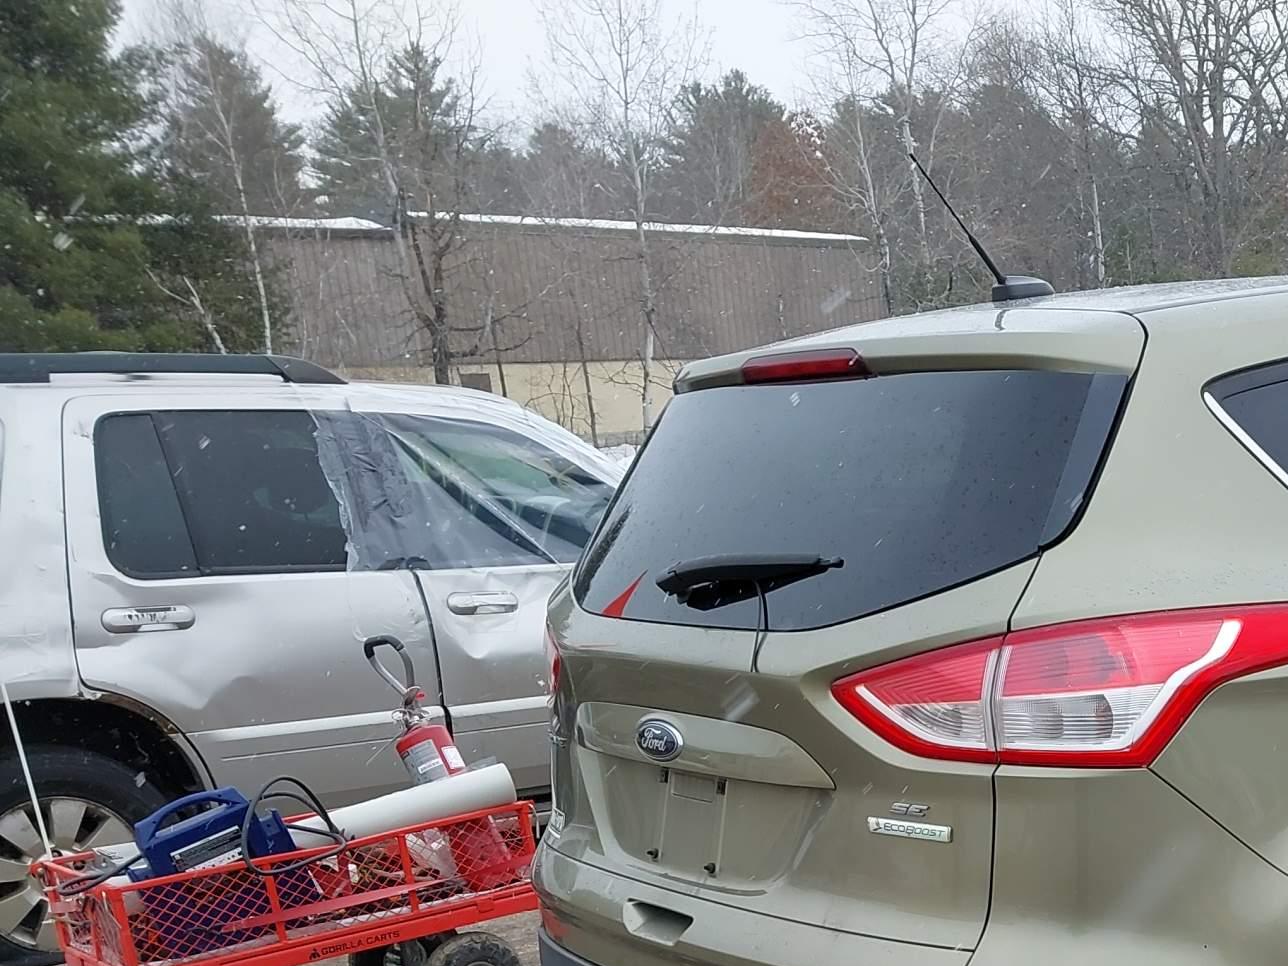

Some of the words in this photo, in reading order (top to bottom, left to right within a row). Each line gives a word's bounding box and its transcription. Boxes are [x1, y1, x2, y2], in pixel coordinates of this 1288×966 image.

[641, 727, 668, 752] Ford
[889, 802, 930, 817] SE
[883, 822, 946, 838] ECOBOOST
[320, 939, 362, 956] GORILLA
[366, 930, 400, 945] CARTS
